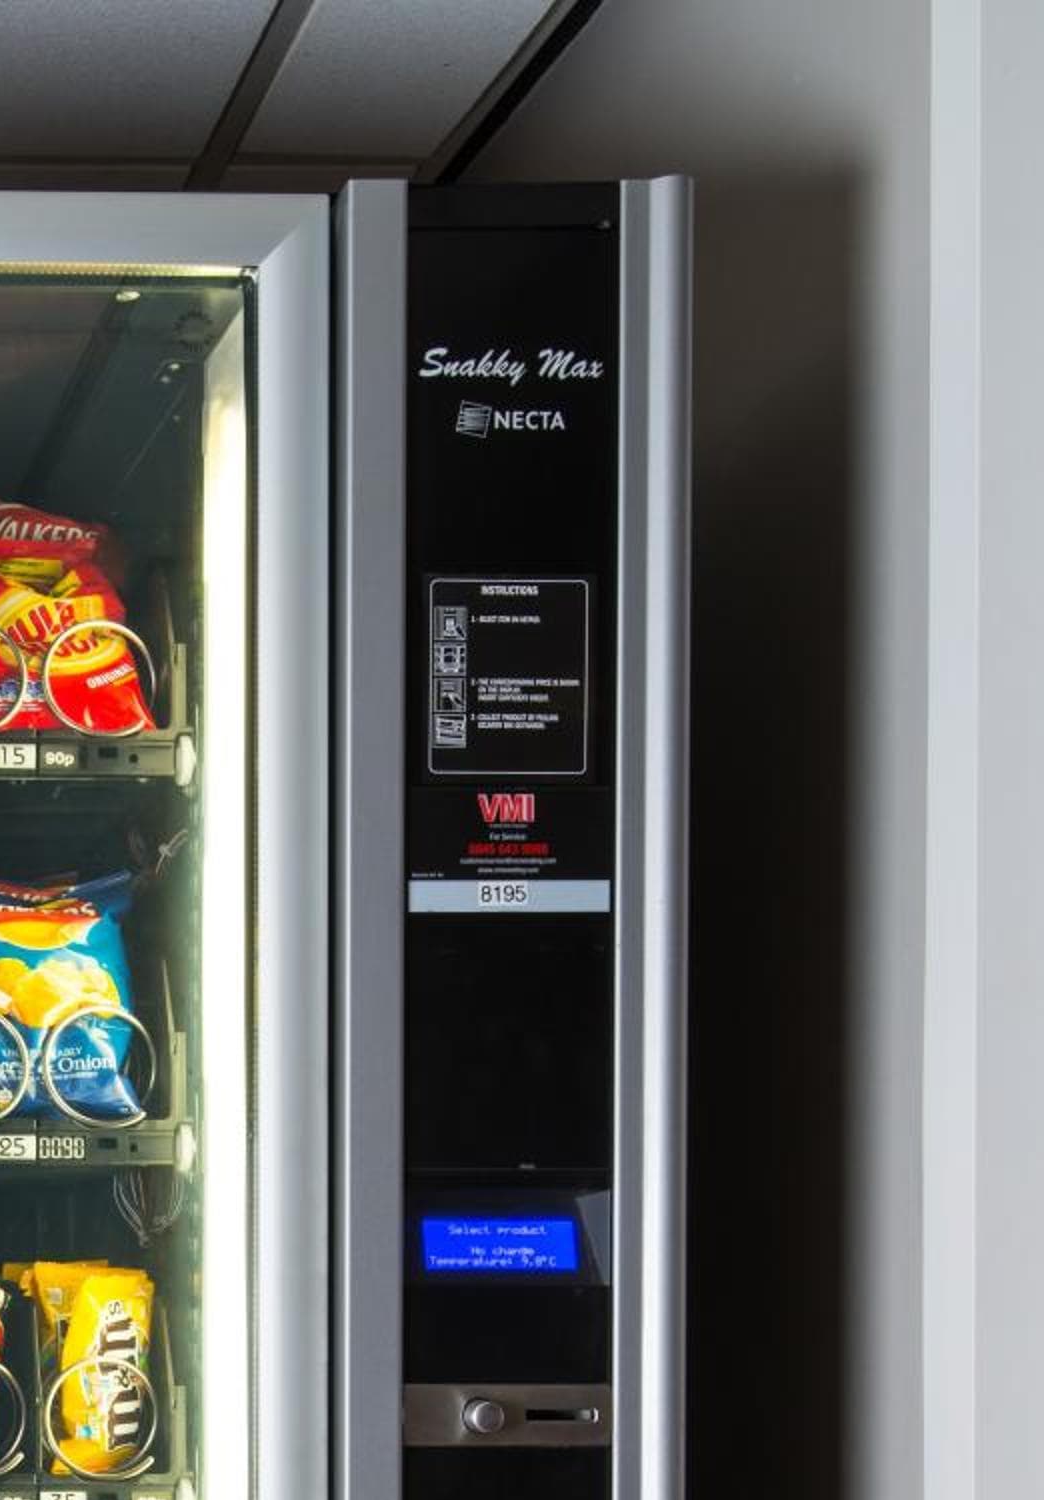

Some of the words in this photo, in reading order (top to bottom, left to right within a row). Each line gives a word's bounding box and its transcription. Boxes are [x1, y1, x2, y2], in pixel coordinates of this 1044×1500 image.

[419, 347, 527, 387] Snakky
[538, 348, 605, 379] Max
[493, 411, 565, 430] NECTA
[2, 746, 26, 765] 15
[44, 750, 75, 766] 90p
[477, 793, 535, 823] VMI
[481, 885, 527, 903] 8195
[0, 1138, 26, 1156] 25
[448, 1224, 491, 1235] Select
